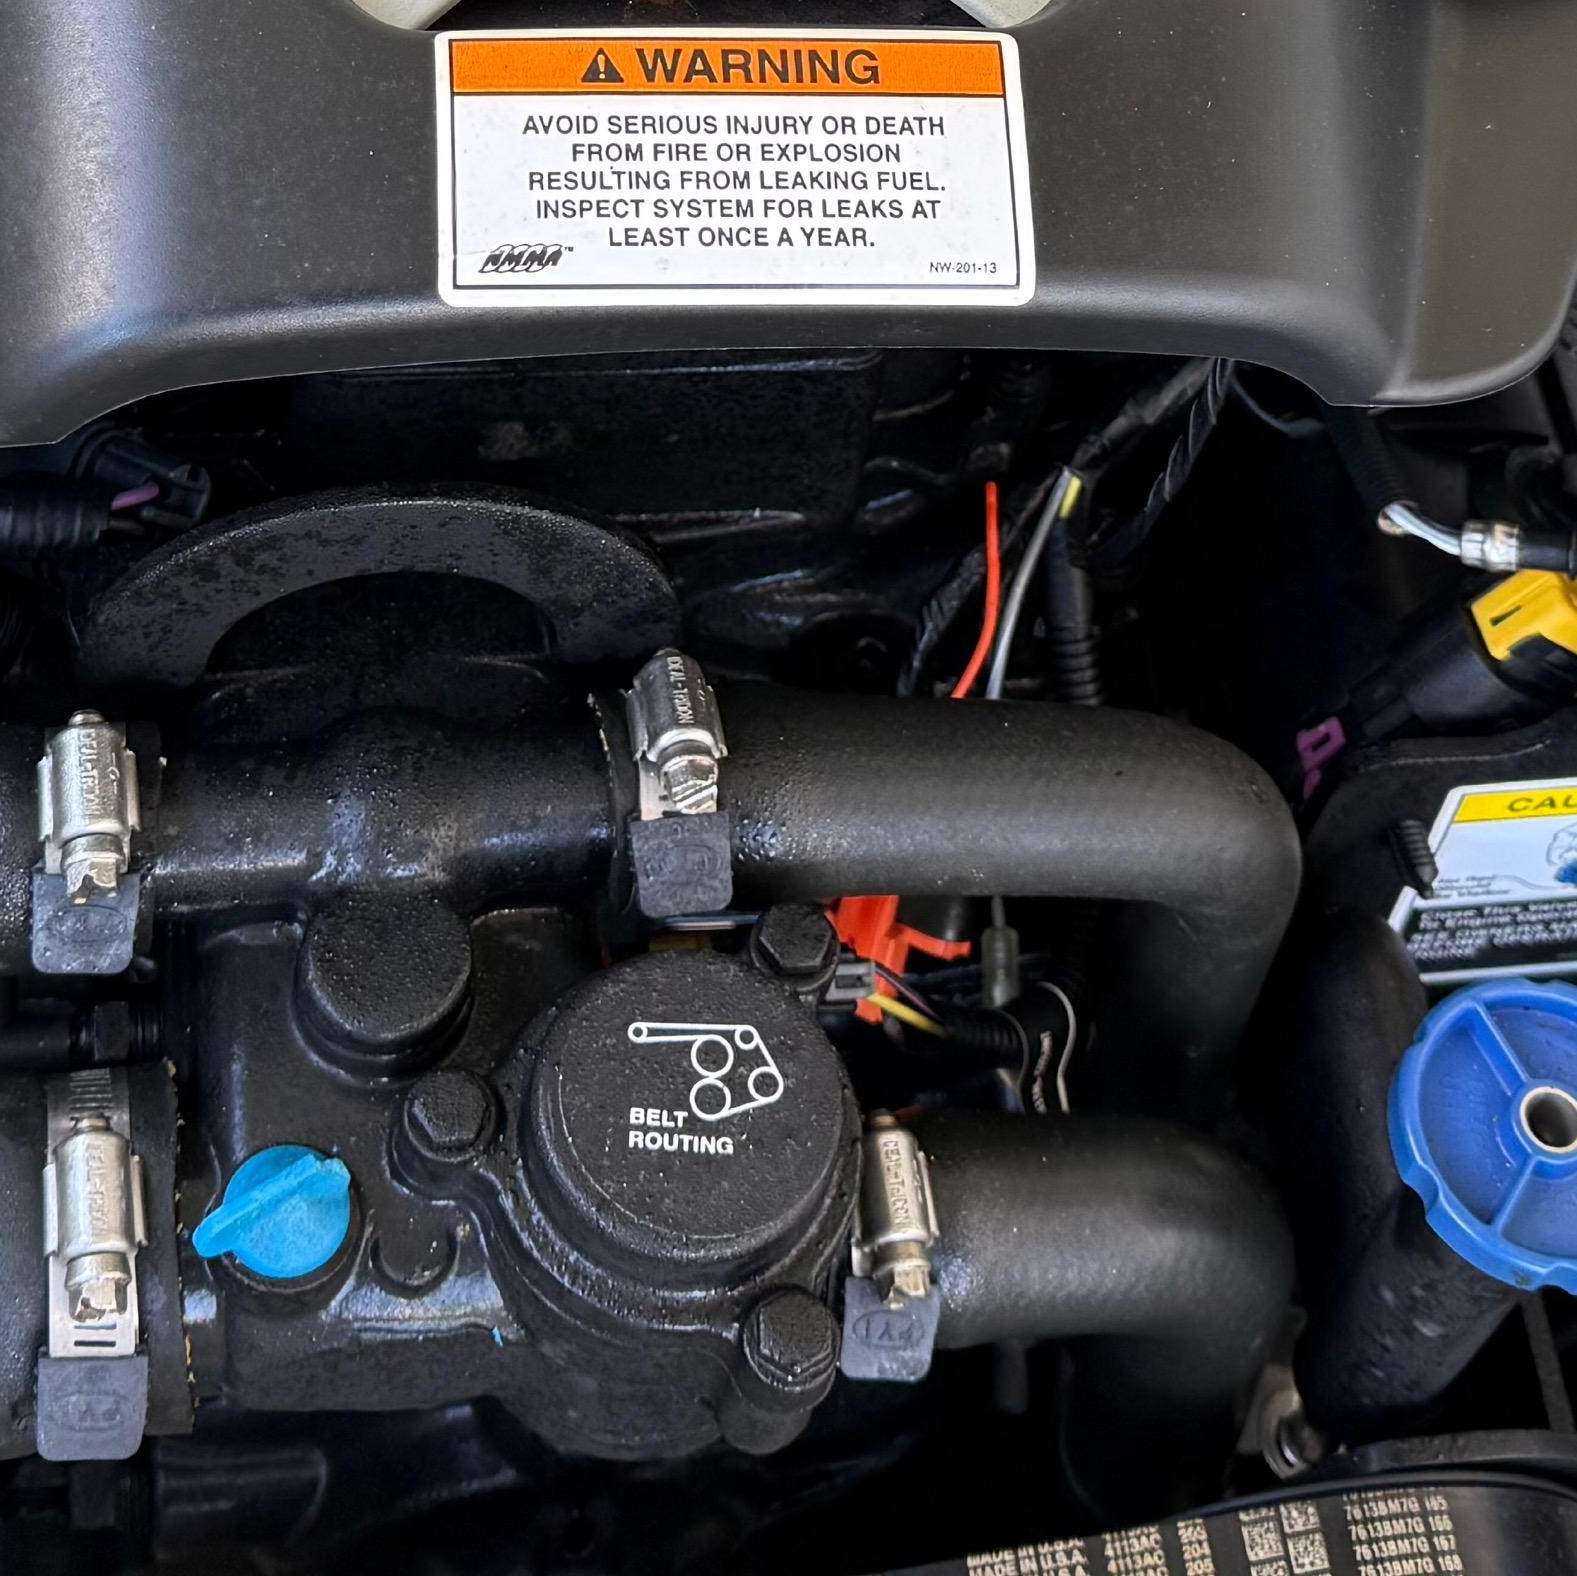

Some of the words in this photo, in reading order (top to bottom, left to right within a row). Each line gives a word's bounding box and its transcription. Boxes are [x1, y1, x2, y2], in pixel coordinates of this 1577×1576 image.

[635, 48, 880, 85] WARNING
[523, 115, 598, 134] AVOID
[608, 115, 718, 135] SERIOUS
[726, 115, 813, 135] INJURY
[822, 115, 856, 135] OR
[865, 116, 944, 136] DEATH
[572, 143, 643, 162] FROM
[653, 143, 708, 162] FIRE
[716, 143, 751, 162] OR
[761, 143, 900, 163] EXPLOSION
[529, 167, 670, 191] RESULTING
[680, 170, 751, 190] FROM
[760, 170, 868, 190] LEAKING
[877, 171, 946, 191] FUEL.
[537, 198, 645, 219] INSPECT
[653, 198, 754, 218] SYSTEM
[763, 199, 813, 218] FOR
[822, 199, 903, 219] LEAKS
[912, 200, 941, 219] AT
[609, 227, 690, 247] LEAST
[698, 227, 769, 247] ONCE
[777, 227, 794, 247] A
[800, 227, 875, 247] YEAR.
[928, 261, 998, 276] NW-201-13
[629, 1106, 689, 1129] BELT
[628, 1130, 735, 1156] ROUTING
[1427, 1514, 1454, 1532] 166
[1181, 1541, 1212, 1560] 204
[1432, 1533, 1458, 1552] 167
[1185, 1559, 1215, 1576] 205
